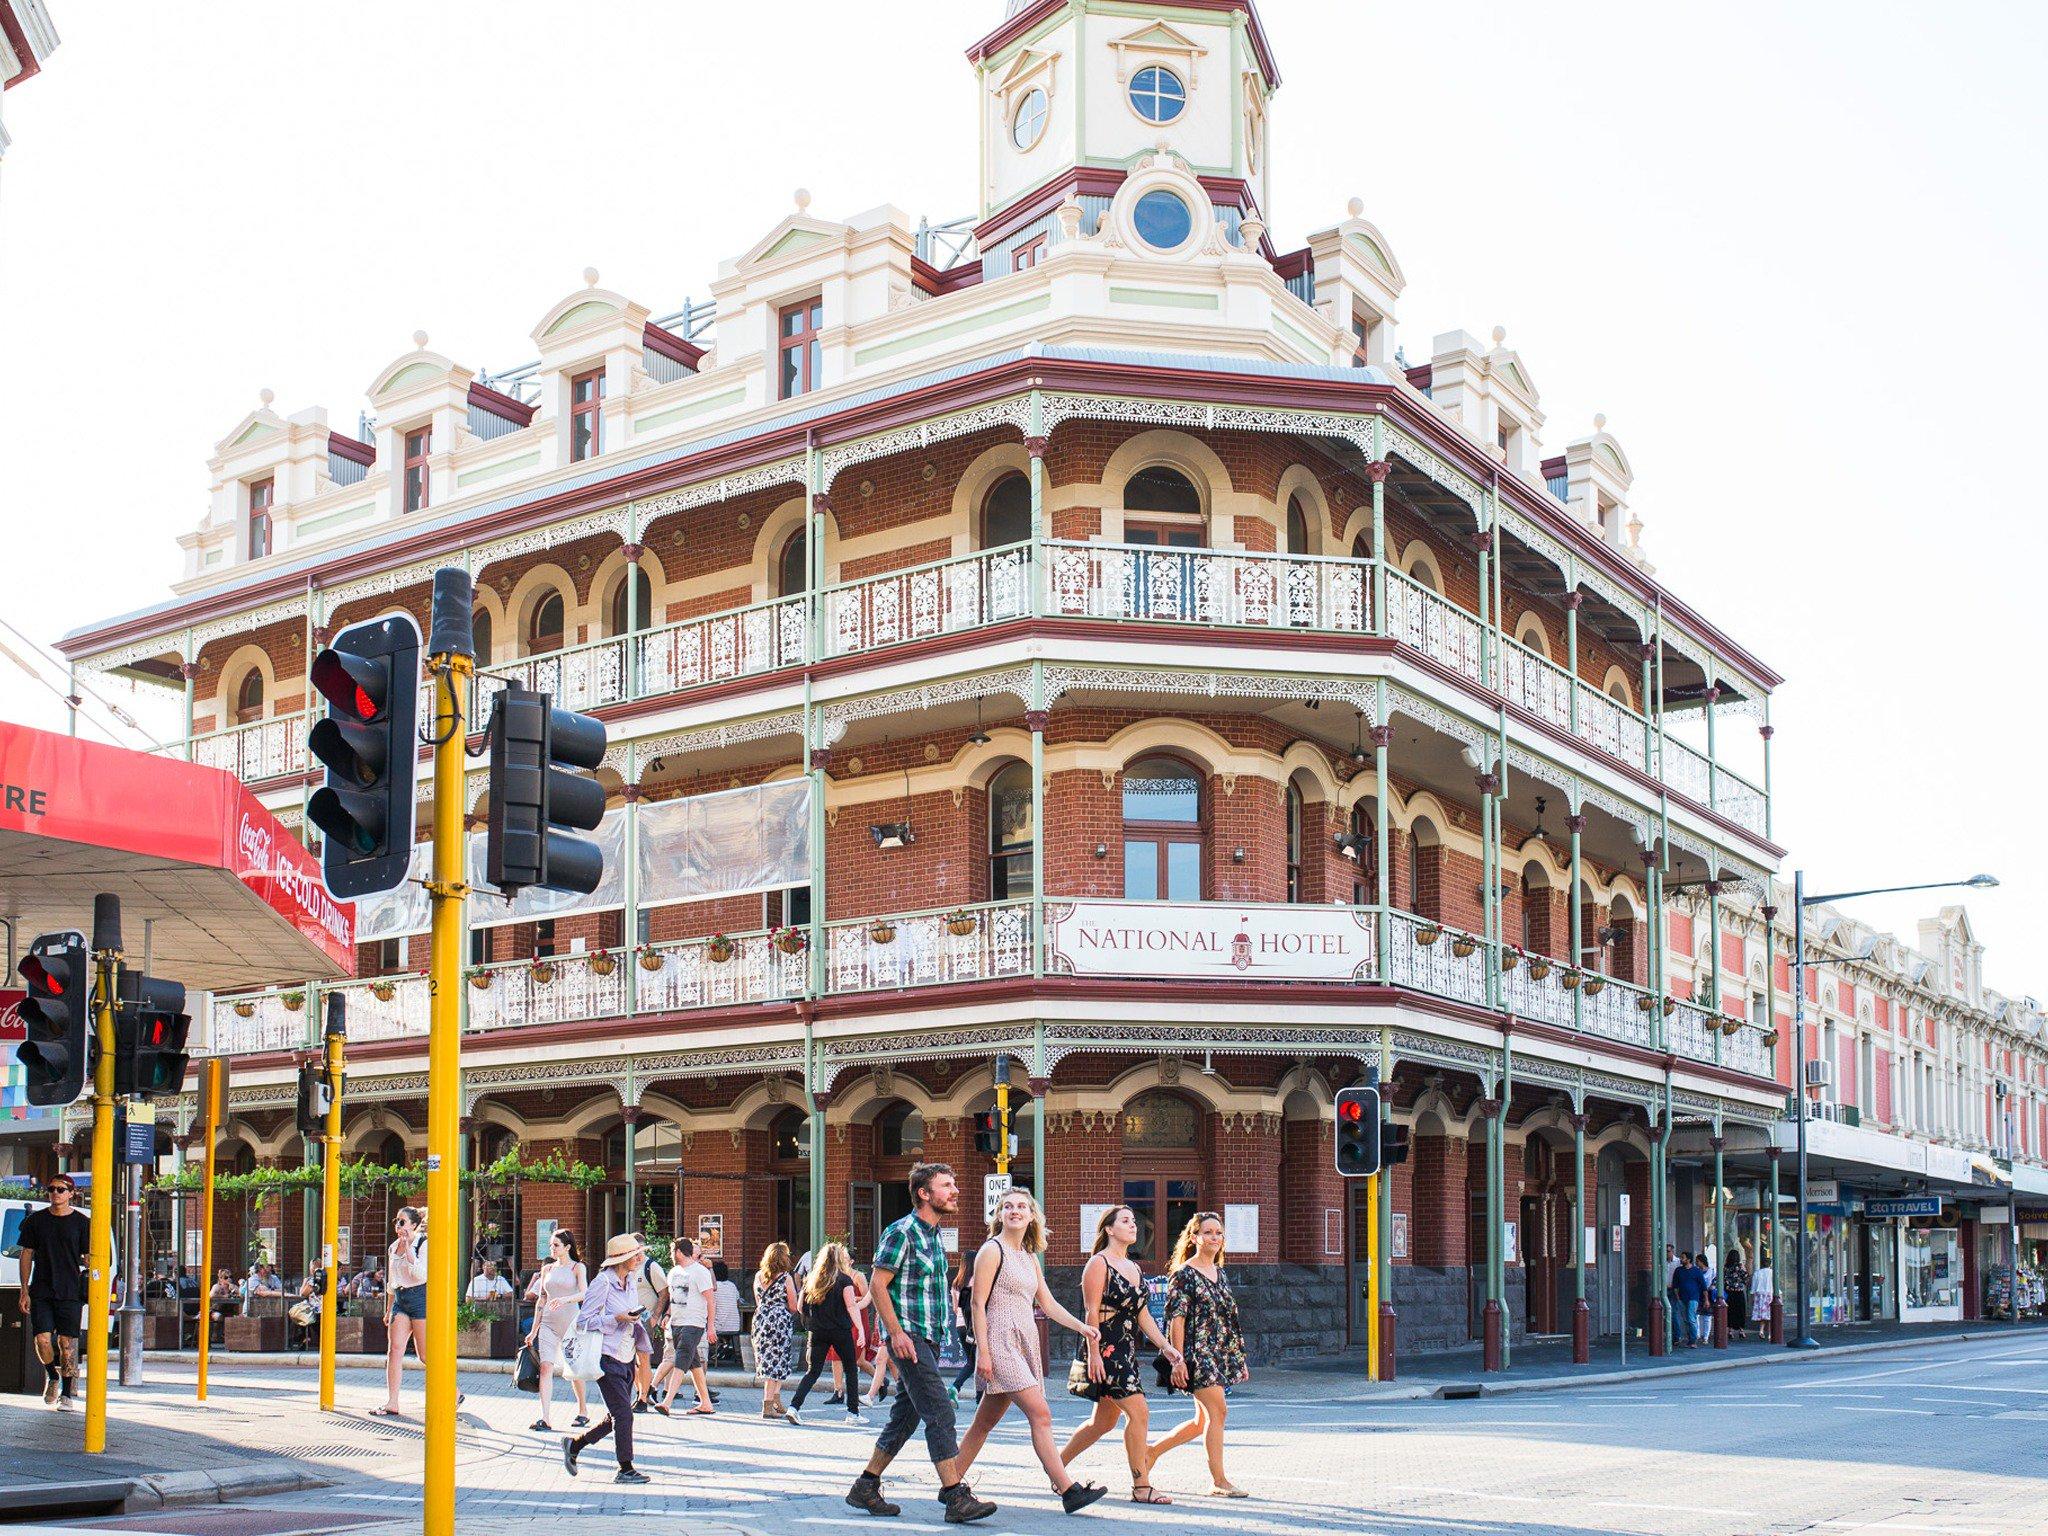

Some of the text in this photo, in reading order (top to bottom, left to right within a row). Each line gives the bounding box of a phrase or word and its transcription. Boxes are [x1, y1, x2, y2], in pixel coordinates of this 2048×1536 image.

[0, 784, 47, 816] RE
[276, 851, 320, 918] ICE-COLD
[320, 894, 350, 948] DRINKS
[1078, 928, 1351, 955] NATIONAL HOTEL
[988, 1179, 1007, 1191] ONE
[987, 1194, 1001, 1206] WA
[1890, 1201, 1935, 1213] TRAVEL
